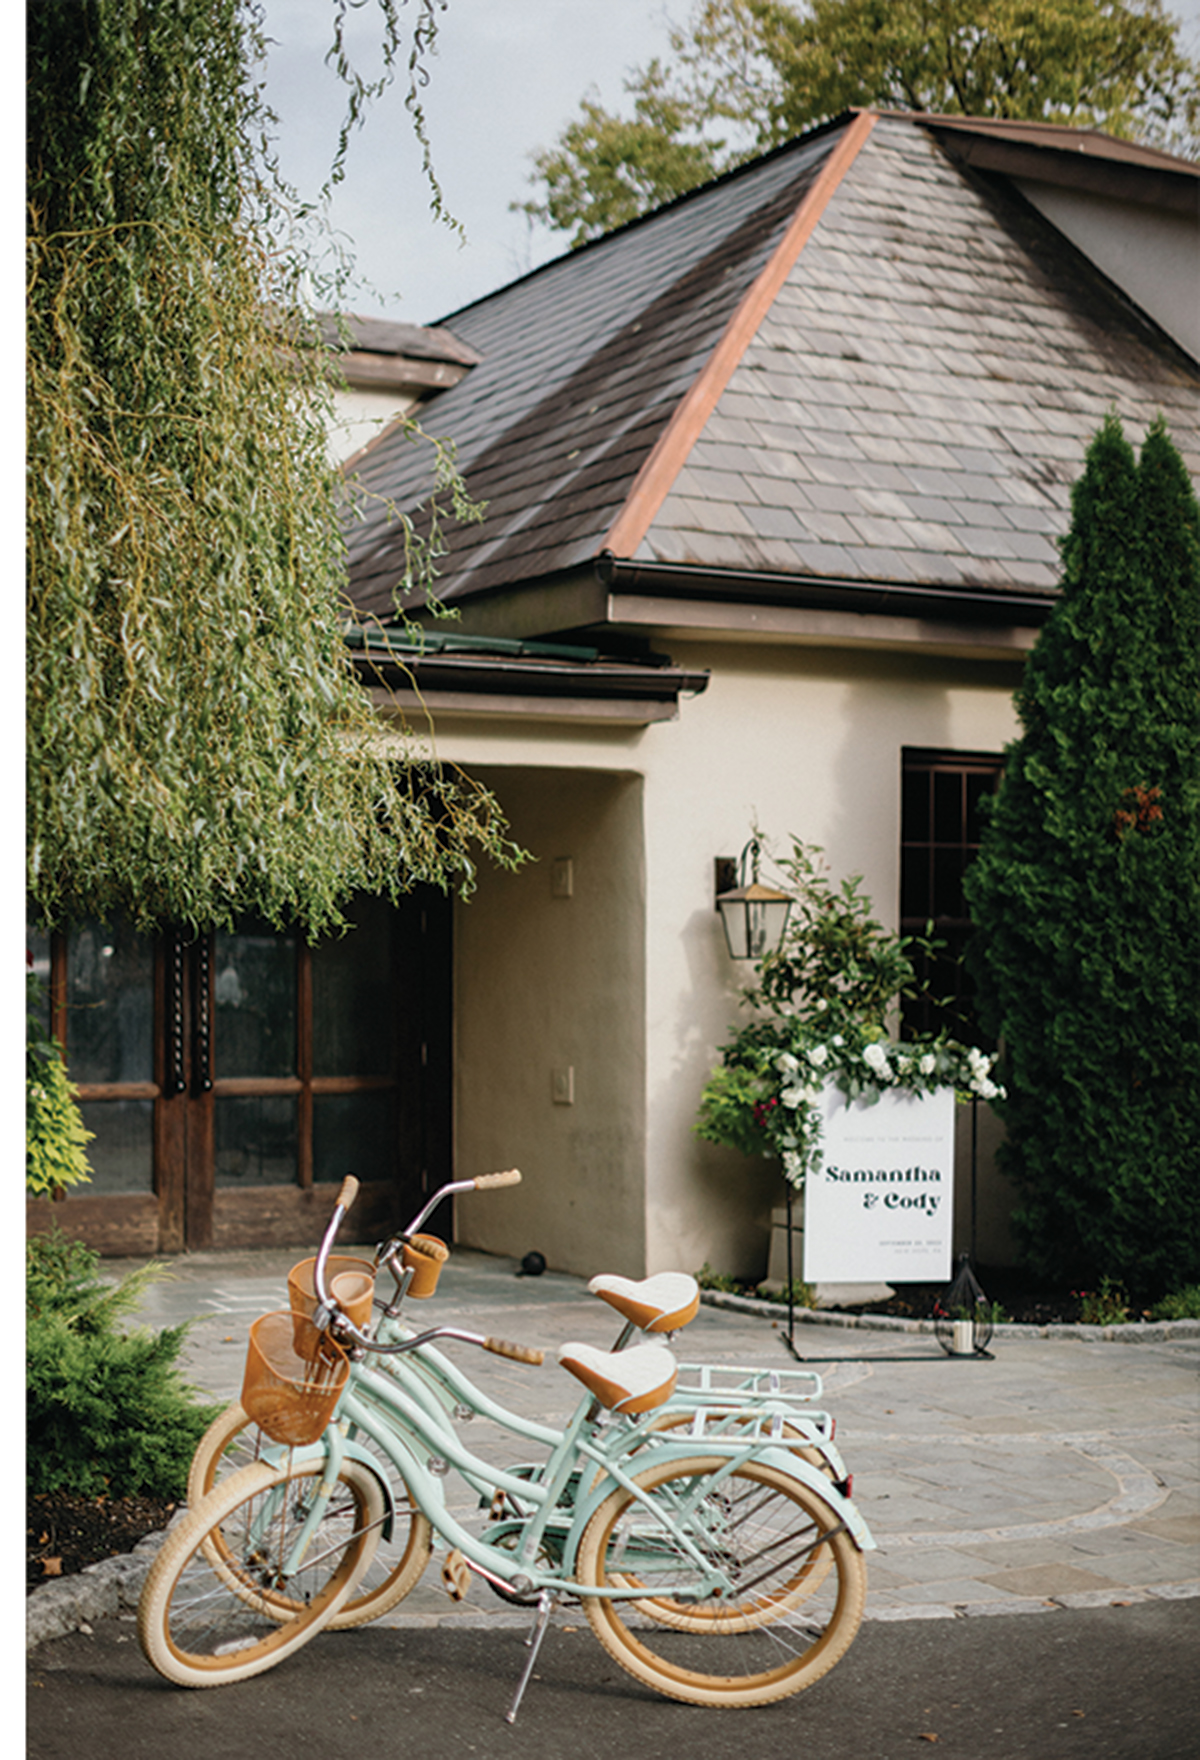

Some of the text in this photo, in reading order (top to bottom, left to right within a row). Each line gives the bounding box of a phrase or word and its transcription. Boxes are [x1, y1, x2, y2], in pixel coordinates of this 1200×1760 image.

[826, 1166, 941, 1182] Samantha
[863, 1192, 941, 1216] & Cody
